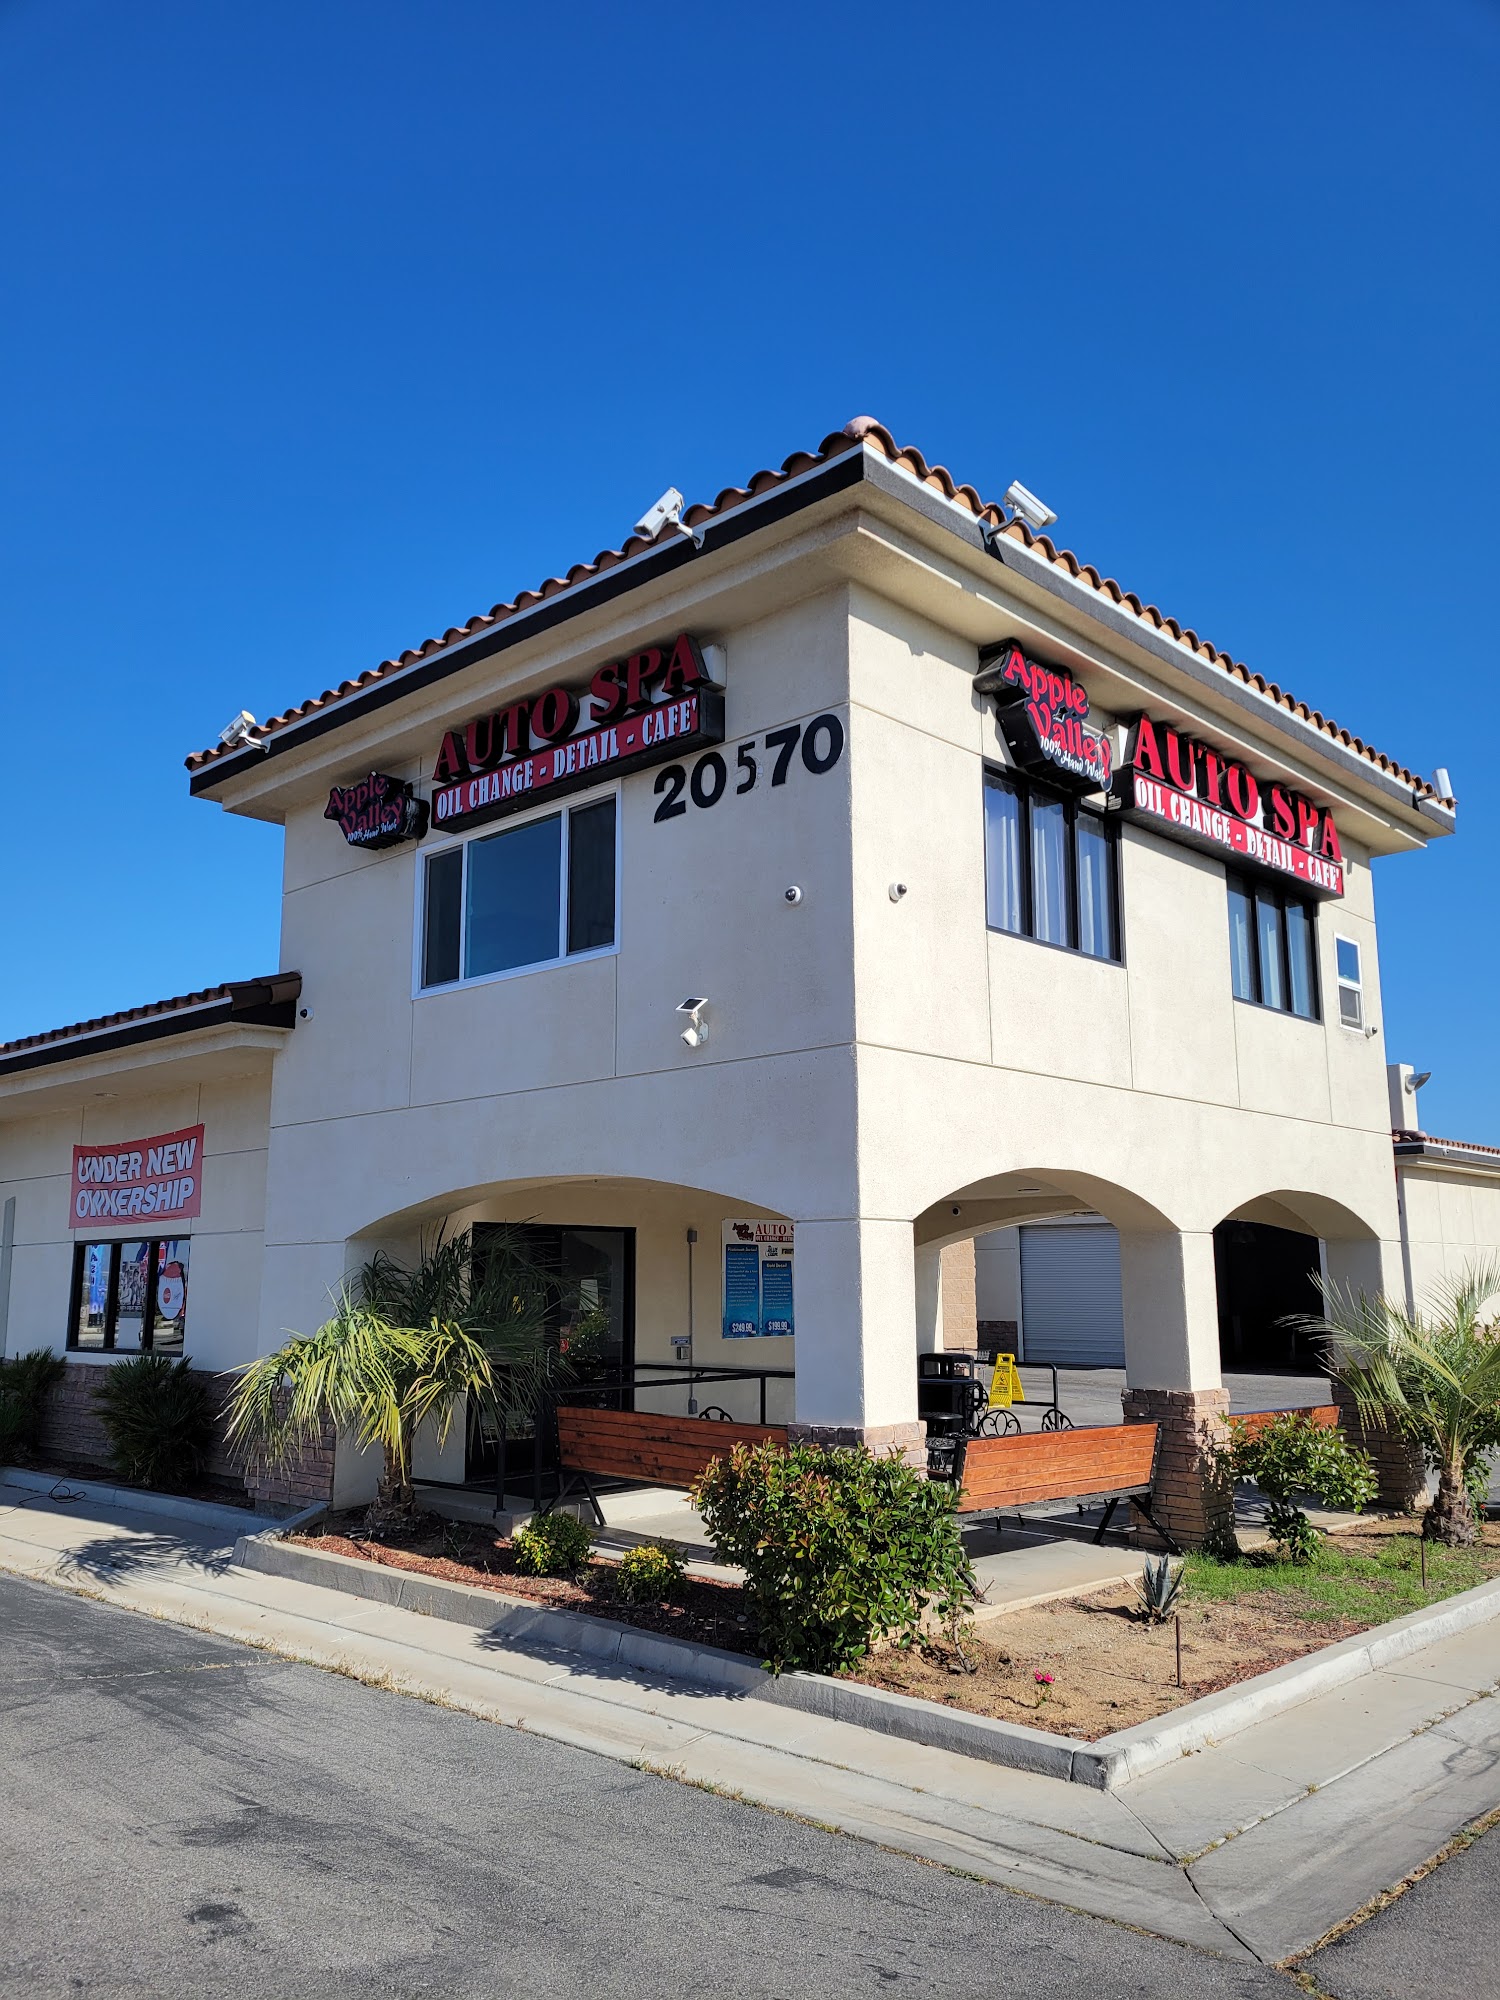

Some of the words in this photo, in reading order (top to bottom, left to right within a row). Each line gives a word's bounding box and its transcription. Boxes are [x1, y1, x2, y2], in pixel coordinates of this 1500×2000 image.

[432, 687, 570, 781] AUTO
[590, 632, 701, 718] SPA
[1004, 646, 1087, 714] Apple
[437, 787, 463, 820] OIL
[469, 759, 534, 808] CHANGE
[553, 728, 619, 778] DETAIL
[653, 713, 844, 823] 20570
[1028, 702, 1110, 779] Valley
[1040, 735, 1061, 756] 100%
[1060, 750, 1084, 771] Hand
[327, 776, 387, 815] Apple
[340, 796, 403, 833] Valley
[1133, 713, 1259, 820] AUTO
[1272, 783, 1343, 863] SPA
[1135, 777, 1165, 816] OIL
[1170, 793, 1231, 844] CHANGE
[1246, 826, 1295, 873] DETAIL
[77, 1151, 143, 1184] UNDER
[146, 1138, 197, 1177] NEW
[76, 1176, 195, 1218] OWNERSHIP
[755, 1223, 787, 1235] AUTO
